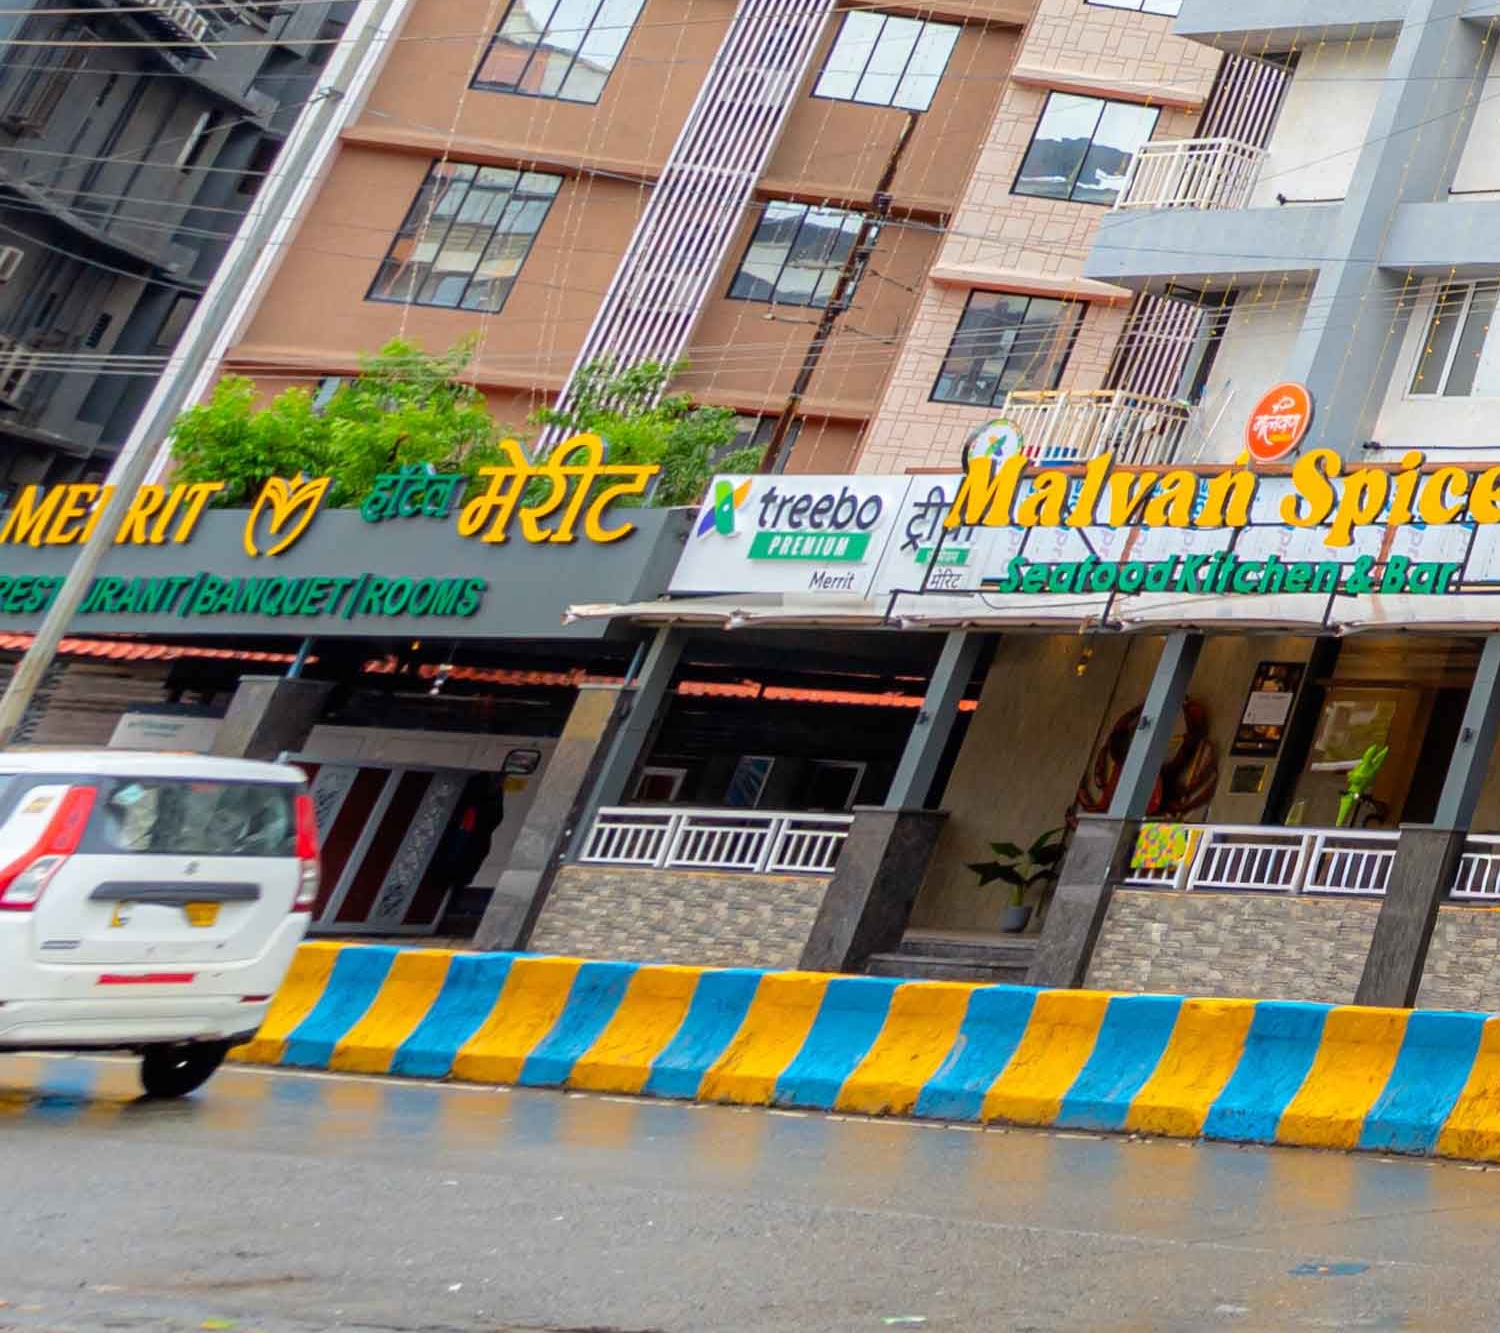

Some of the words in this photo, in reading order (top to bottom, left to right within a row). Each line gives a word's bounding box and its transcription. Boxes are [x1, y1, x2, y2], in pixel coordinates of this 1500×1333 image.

[457, 433, 662, 544] मेरीट
[757, 485, 884, 531] treebo
[944, 452, 1259, 530] Malvan
[767, 534, 851, 557] PREMIUM
[808, 570, 856, 590] Merrit
[1000, 553, 1178, 594] Seafood
[1175, 550, 1341, 594] Kitchen
[1345, 554, 1375, 594] &
[1380, 554, 1459, 595] Bar
